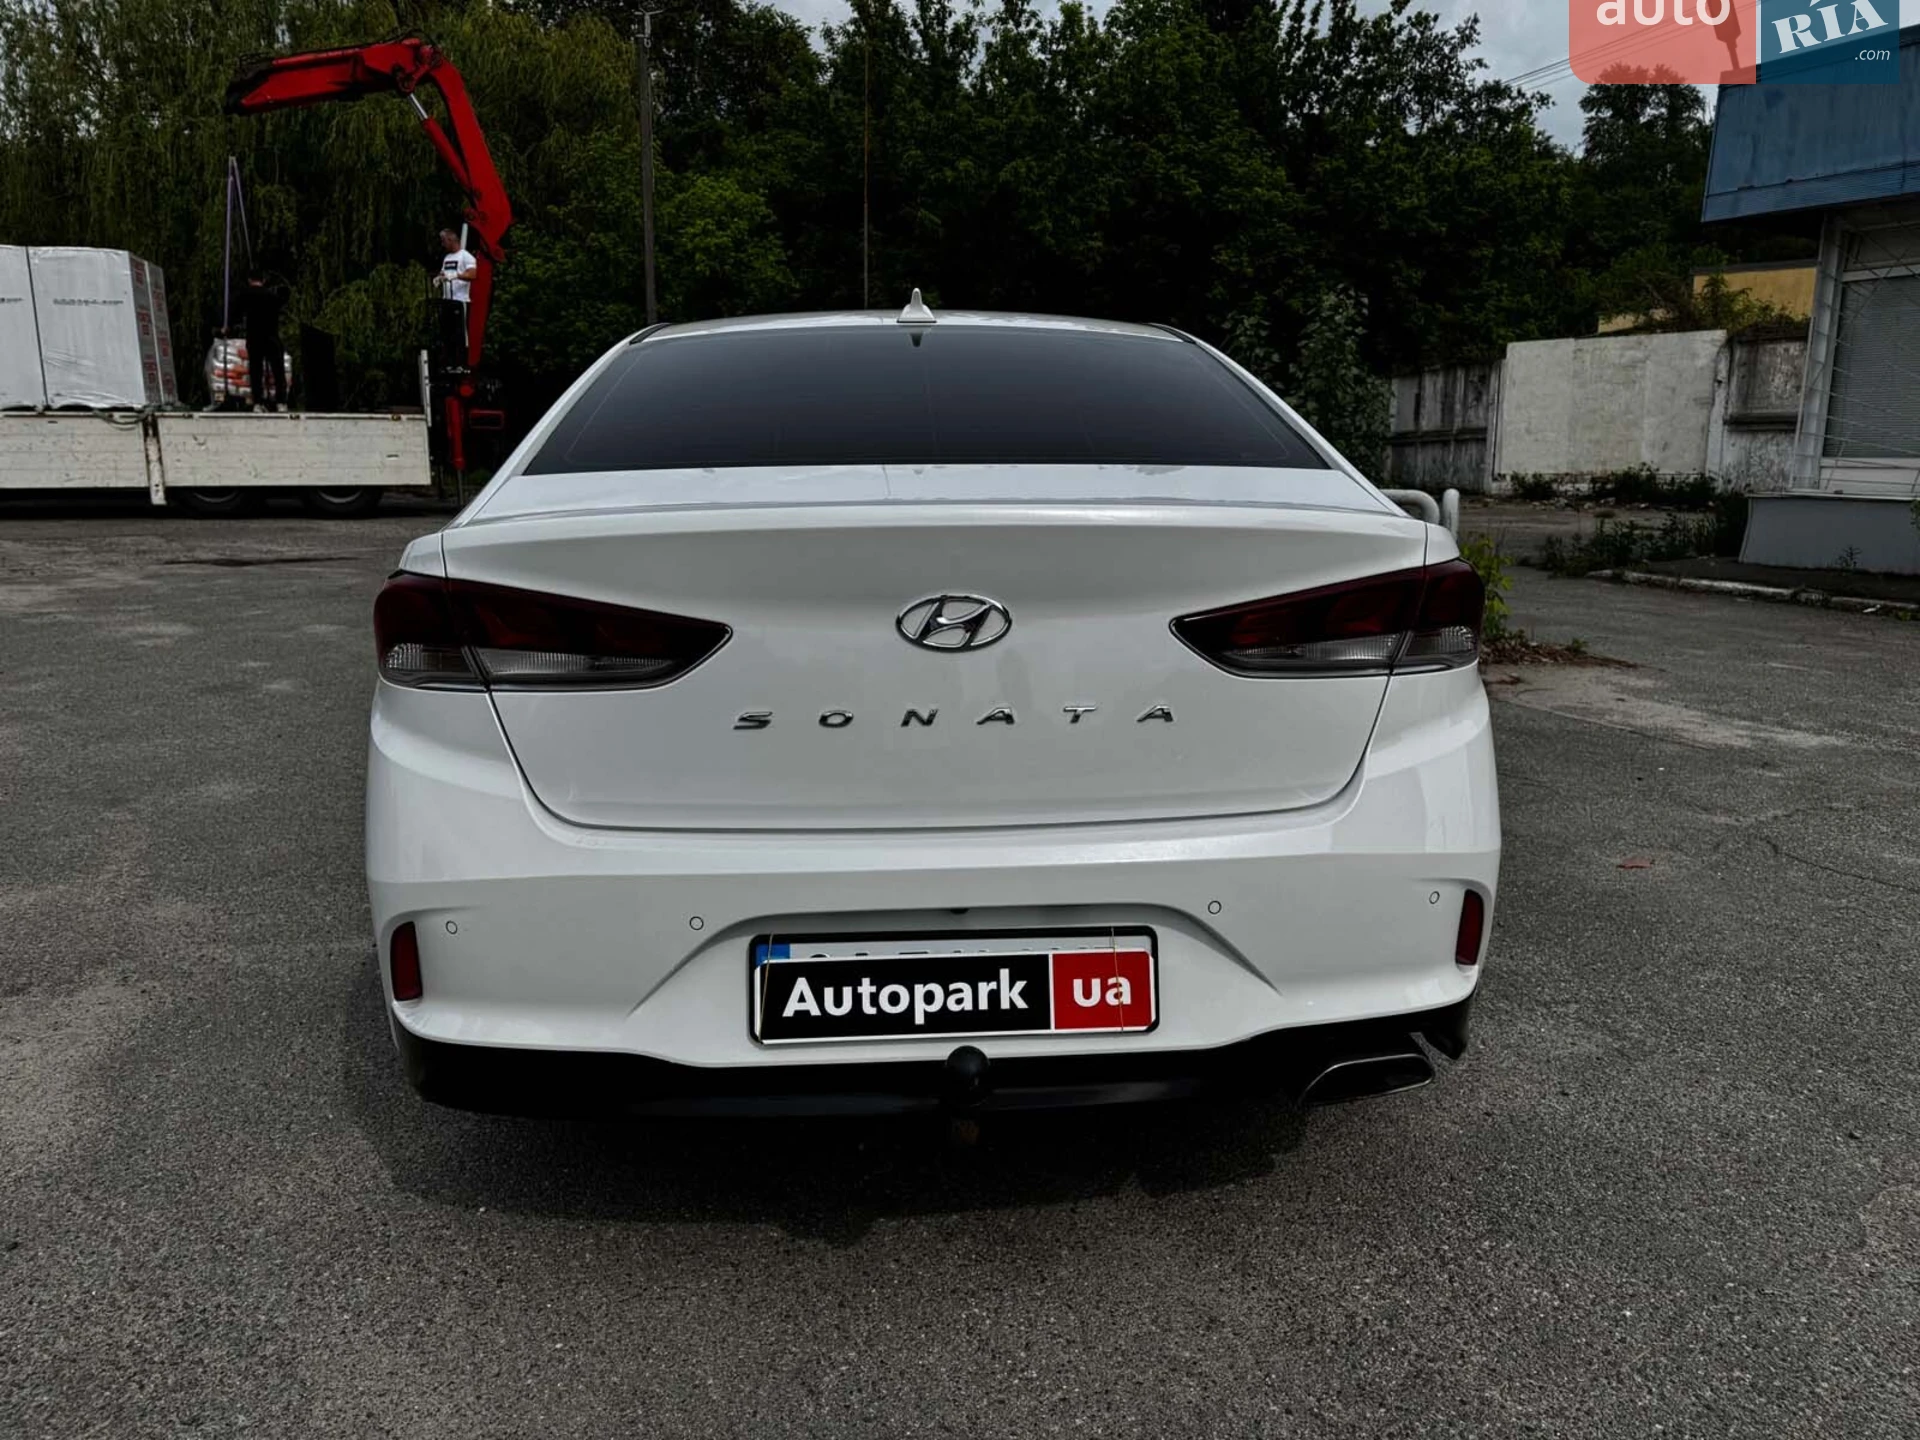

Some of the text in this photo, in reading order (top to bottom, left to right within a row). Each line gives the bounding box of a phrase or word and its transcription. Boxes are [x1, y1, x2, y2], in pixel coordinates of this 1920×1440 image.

[733, 704, 1175, 730] SONATA
[781, 967, 1132, 1025] Autopark ua
